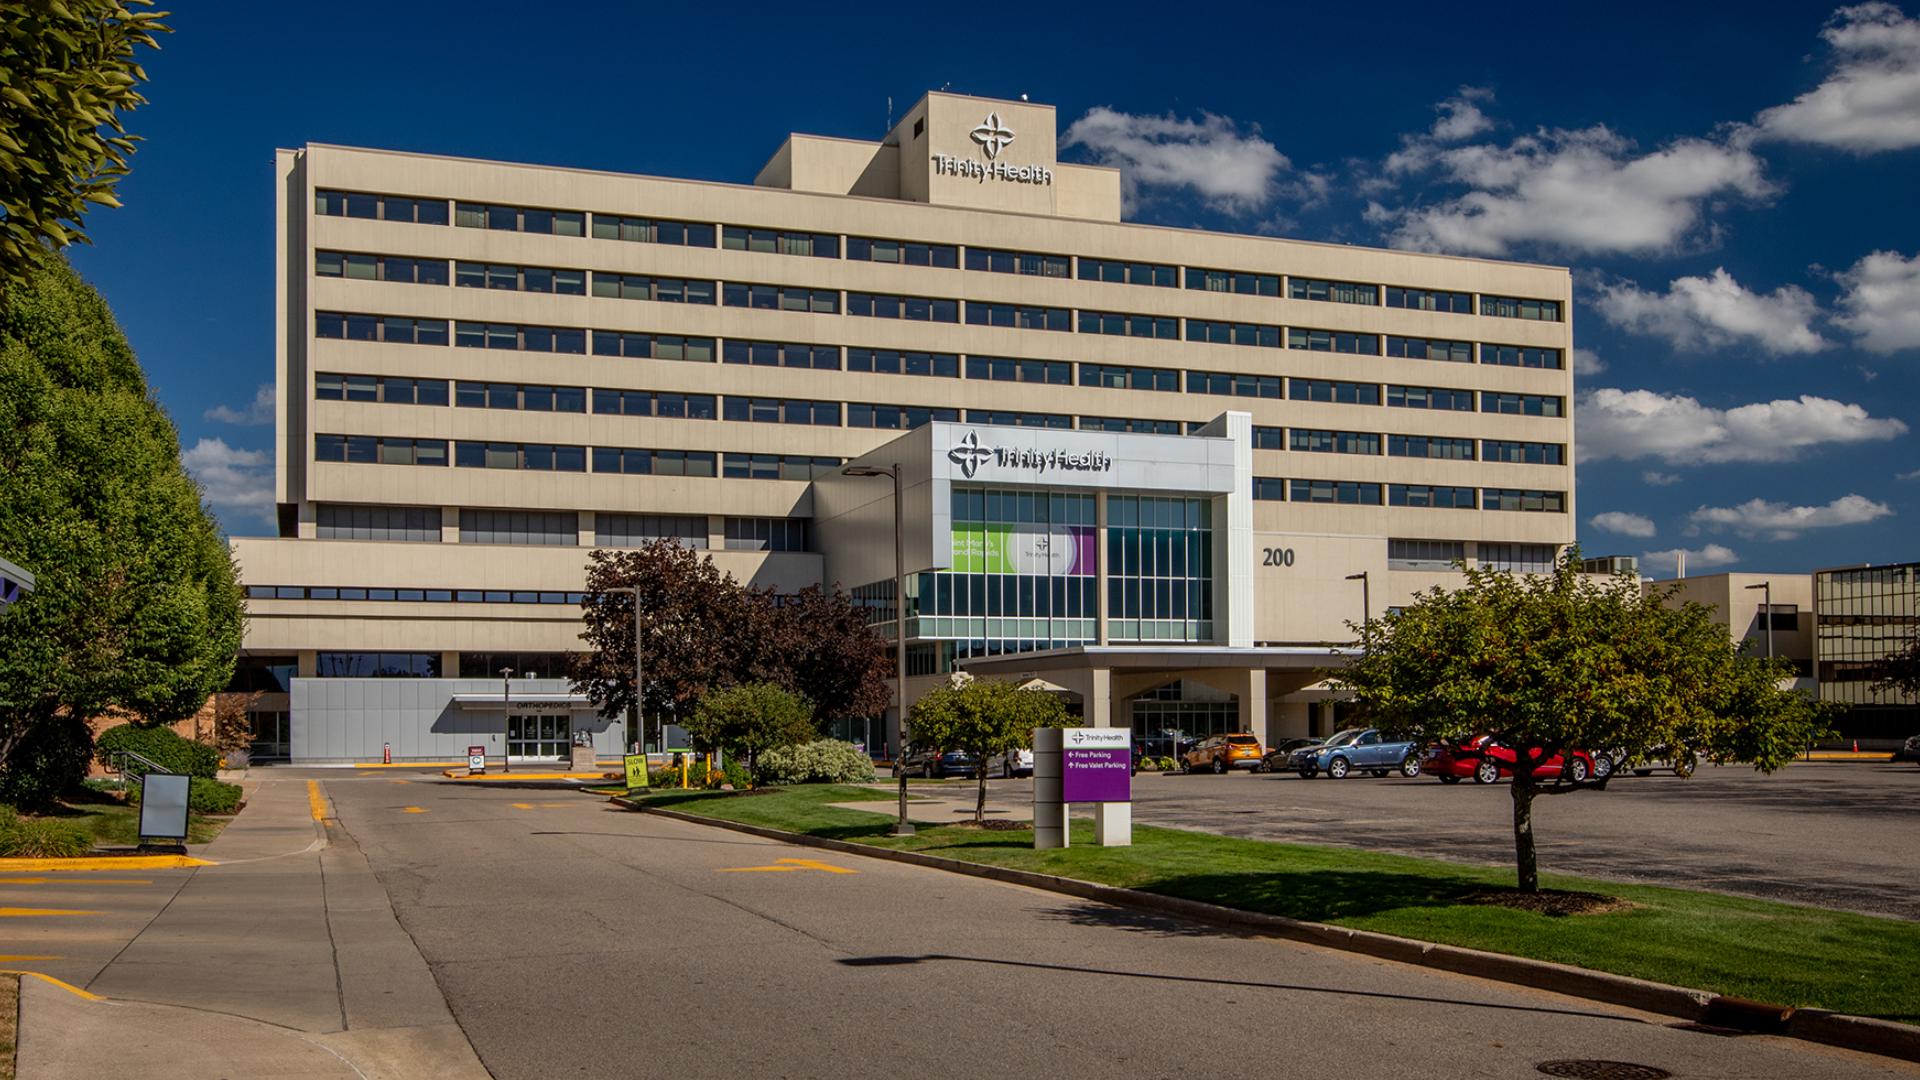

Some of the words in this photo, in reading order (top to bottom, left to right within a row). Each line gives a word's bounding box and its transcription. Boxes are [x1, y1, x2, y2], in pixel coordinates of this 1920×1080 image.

[934, 153, 992, 181] Trinity
[994, 161, 1053, 183] Health
[996, 446, 1050, 472] Trinity
[1053, 448, 1112, 471] Health
[1025, 551, 1042, 559] Triity
[1263, 548, 1294, 567] 200
[1086, 734, 1103, 742] Trinity
